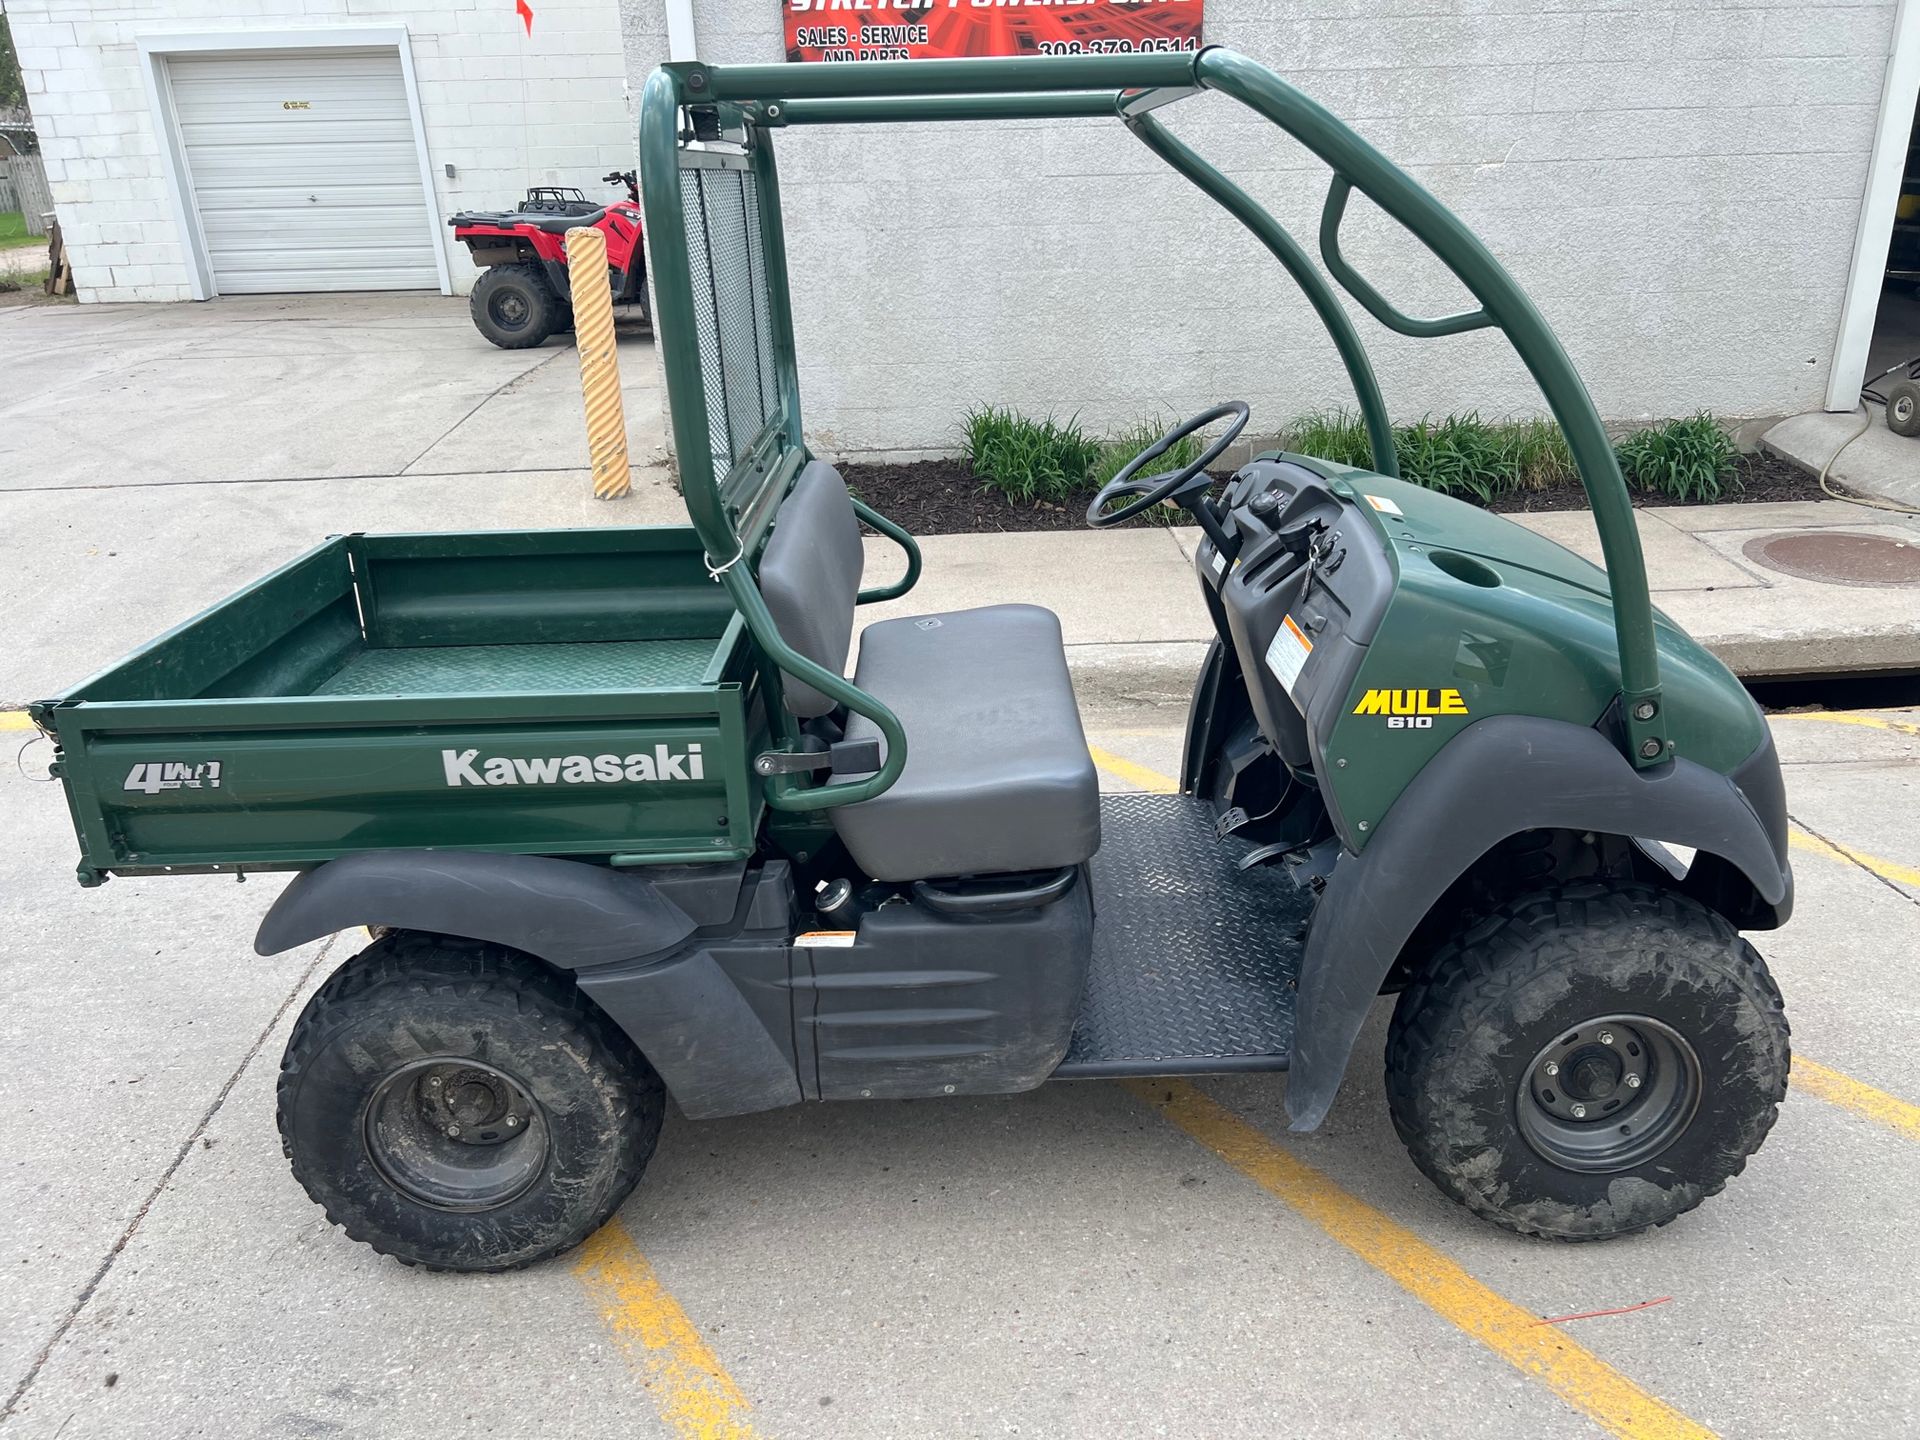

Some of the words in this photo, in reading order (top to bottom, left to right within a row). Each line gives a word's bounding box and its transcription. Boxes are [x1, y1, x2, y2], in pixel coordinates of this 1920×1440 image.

[797, 27, 848, 46] SALES
[861, 25, 928, 45] SERVICE
[823, 49, 856, 62] AND
[859, 48, 910, 61] PARTS
[1039, 37, 1197, 55] 308-379-0511
[1352, 688, 1470, 715] MULE
[1387, 716, 1433, 729] 610
[442, 743, 704, 787] Kawasaki
